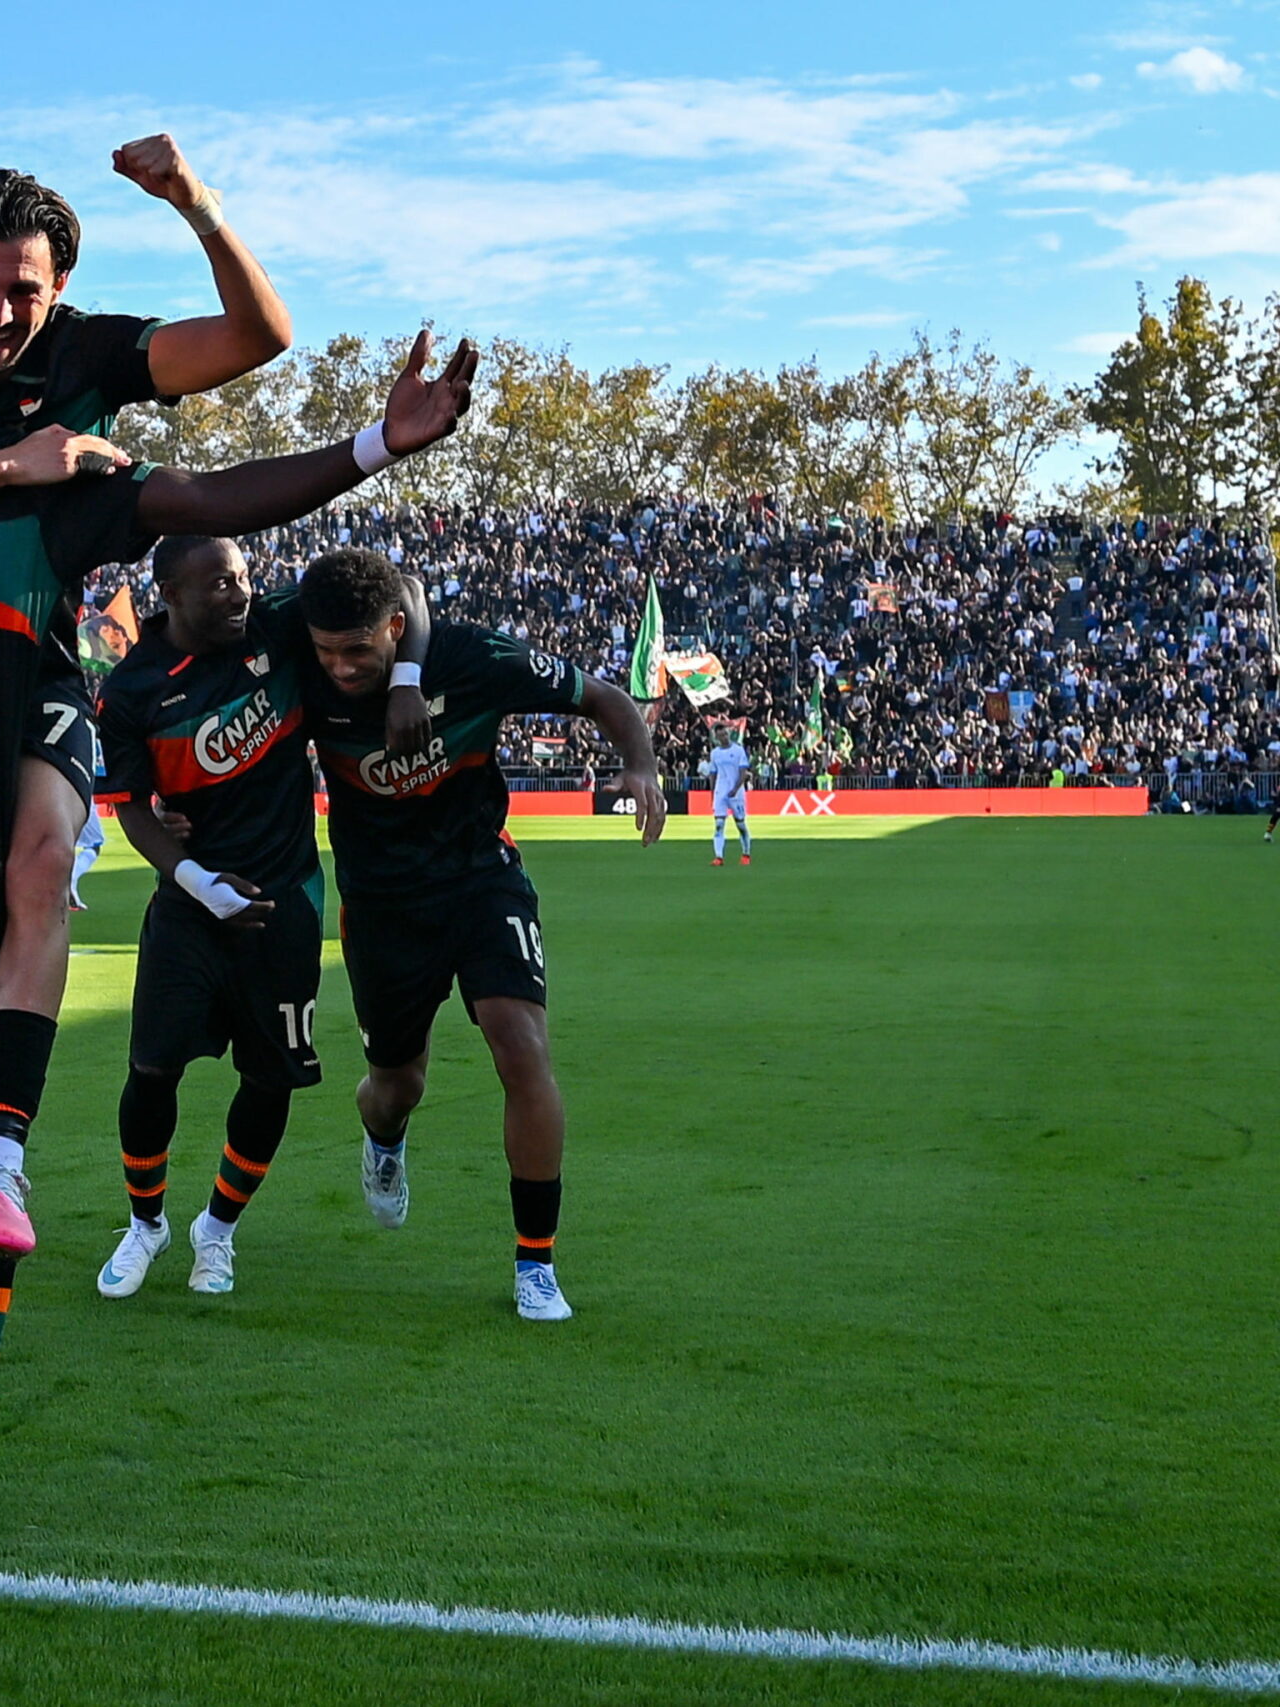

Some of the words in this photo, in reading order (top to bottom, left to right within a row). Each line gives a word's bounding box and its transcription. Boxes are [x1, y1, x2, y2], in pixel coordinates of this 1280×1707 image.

[43, 702, 79, 745] 7
[194, 688, 271, 775] CYNAR
[240, 710, 282, 762] SPRITZ
[360, 736, 445, 796] CYNAR
[401, 757, 450, 793] SPRITZ
[780, 792, 837, 816] AX
[506, 916, 544, 968] 19
